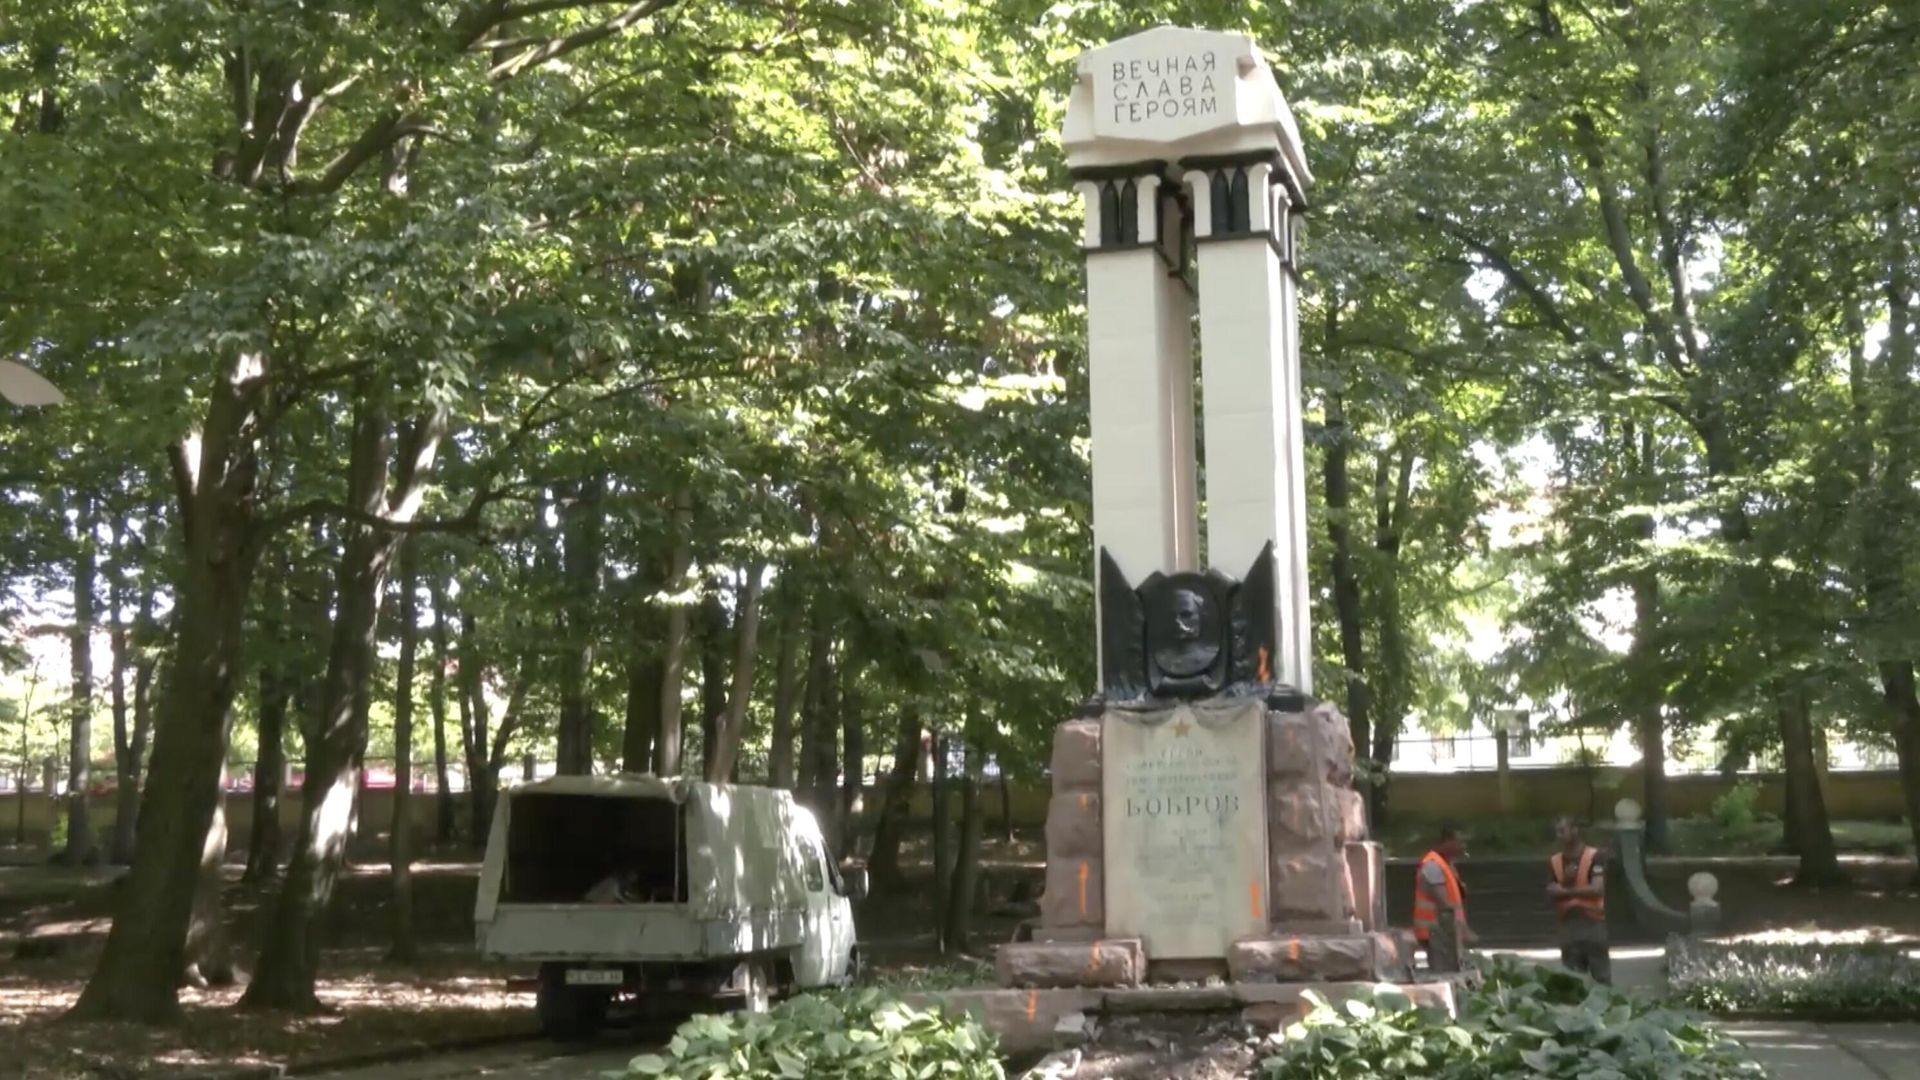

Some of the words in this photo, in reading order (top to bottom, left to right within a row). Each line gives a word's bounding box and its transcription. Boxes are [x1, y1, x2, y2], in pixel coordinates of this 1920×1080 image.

[1112, 51, 1216, 82] ВЕЧНАЯ
[1112, 75, 1216, 102] СЛАВА
[1113, 97, 1217, 123] ГЕРОЯМ
